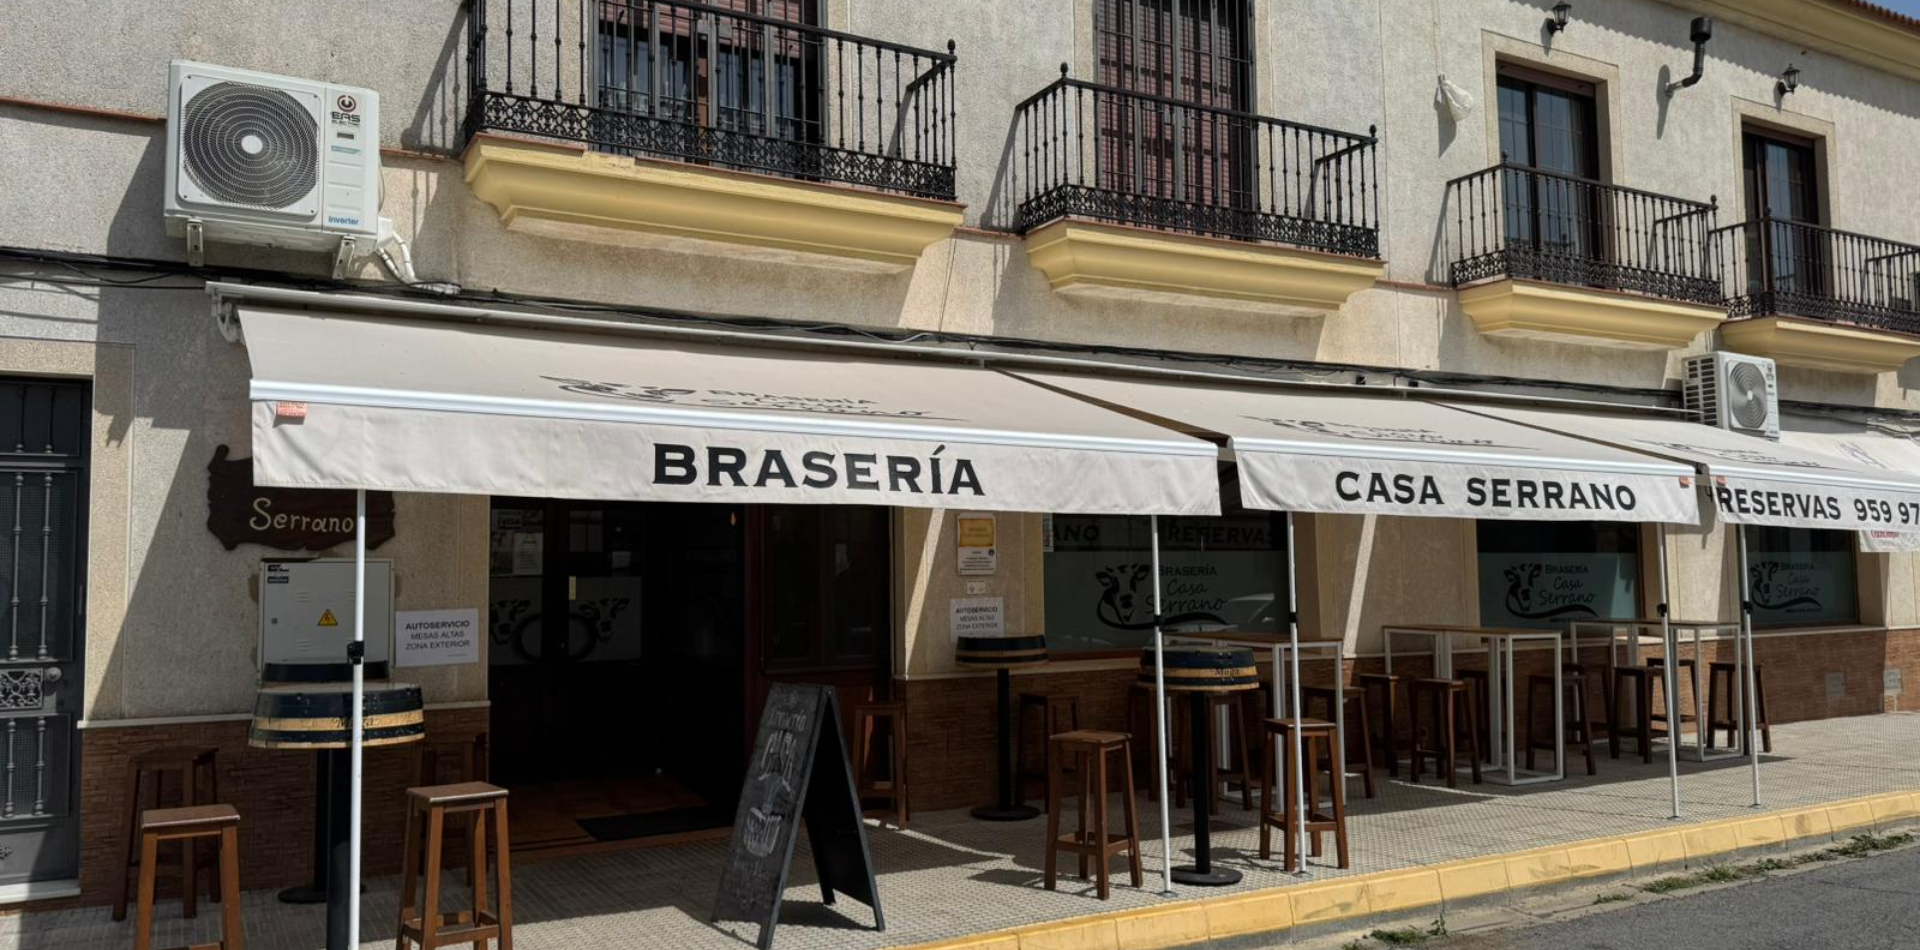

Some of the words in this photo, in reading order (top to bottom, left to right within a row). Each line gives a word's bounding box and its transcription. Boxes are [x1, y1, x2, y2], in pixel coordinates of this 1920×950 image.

[331, 111, 361, 123] EAS
[652, 443, 985, 496] BRASERÍA
[1335, 471, 1445, 505] CASA
[1466, 476, 1637, 511] SERRANO
[1716, 485, 1841, 520] RESERVAS
[1855, 498, 1892, 523] 959
[1898, 502, 1920, 525] 97
[249, 497, 354, 533] Serrano
[1159, 563, 1218, 576] BRASERÍA
[1545, 562, 1588, 574] BRASERÍA
[1167, 579, 1209, 596] Casa
[1553, 575, 1583, 590] Casa
[1538, 589, 1597, 606] Serrano
[956, 606, 998, 614] AUTOSERVICIO
[405, 620, 470, 630] AUTOSERVICIO
[972, 622, 998, 630] EXTERIOR
[411, 632, 439, 640] MESAS
[441, 630, 465, 639] ALTAS
[405, 642, 428, 651] ZONA
[430, 640, 470, 649] EXTERIOR
